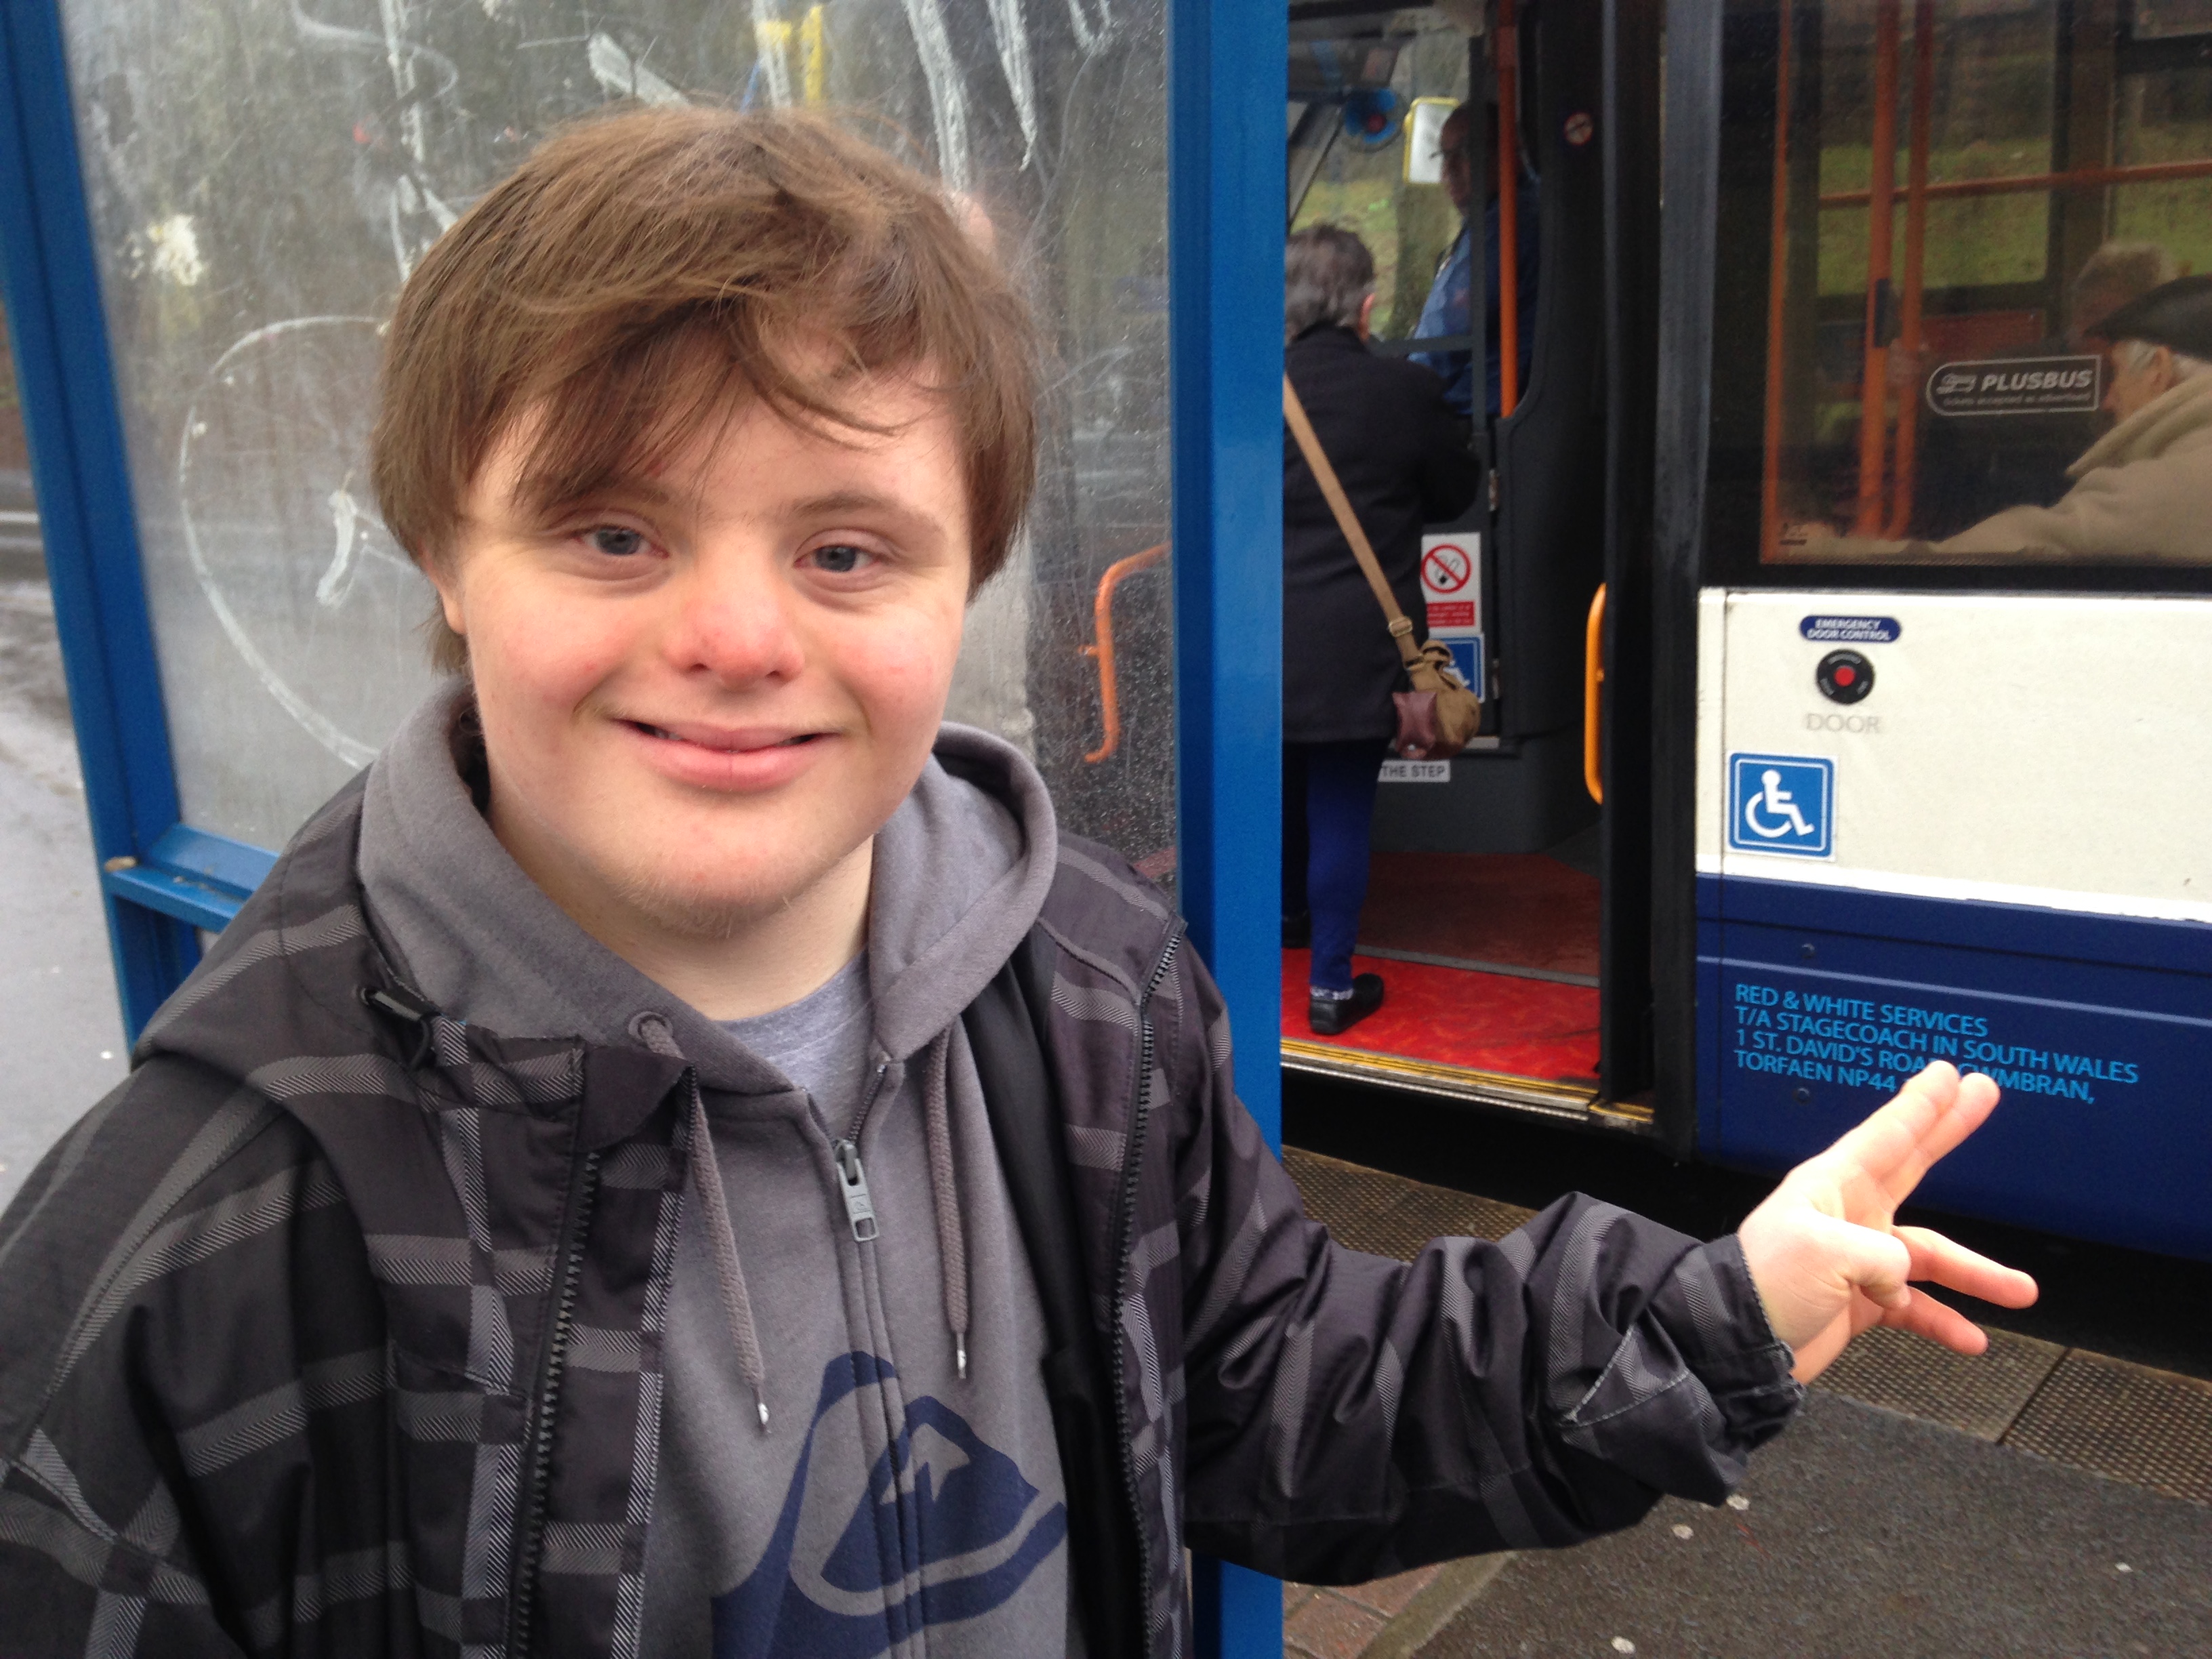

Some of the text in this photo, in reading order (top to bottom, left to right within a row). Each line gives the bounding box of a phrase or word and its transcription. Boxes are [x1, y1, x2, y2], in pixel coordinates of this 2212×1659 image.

[1981, 370, 2093, 392] PLUSBUS
[1807, 629, 1891, 641] DOOR CONTROL
[1815, 619, 1881, 630] EMERGENCY
[1807, 713, 1880, 733] DOOR
[1382, 765, 1445, 777] THE STEP
[1736, 984, 1988, 1037] RED & WHITE SERVICES
[1734, 1005, 2139, 1084] T/A STAGECOACH IN SOUTH WALES
[1736, 1029, 1745, 1046] 1
[1753, 1030, 1782, 1052] ST.
[1786, 1035, 1873, 1066] DAVID'S
[1879, 1050, 1938, 1073] ROA
[1734, 1049, 1896, 1092] TORFAEN NP44
